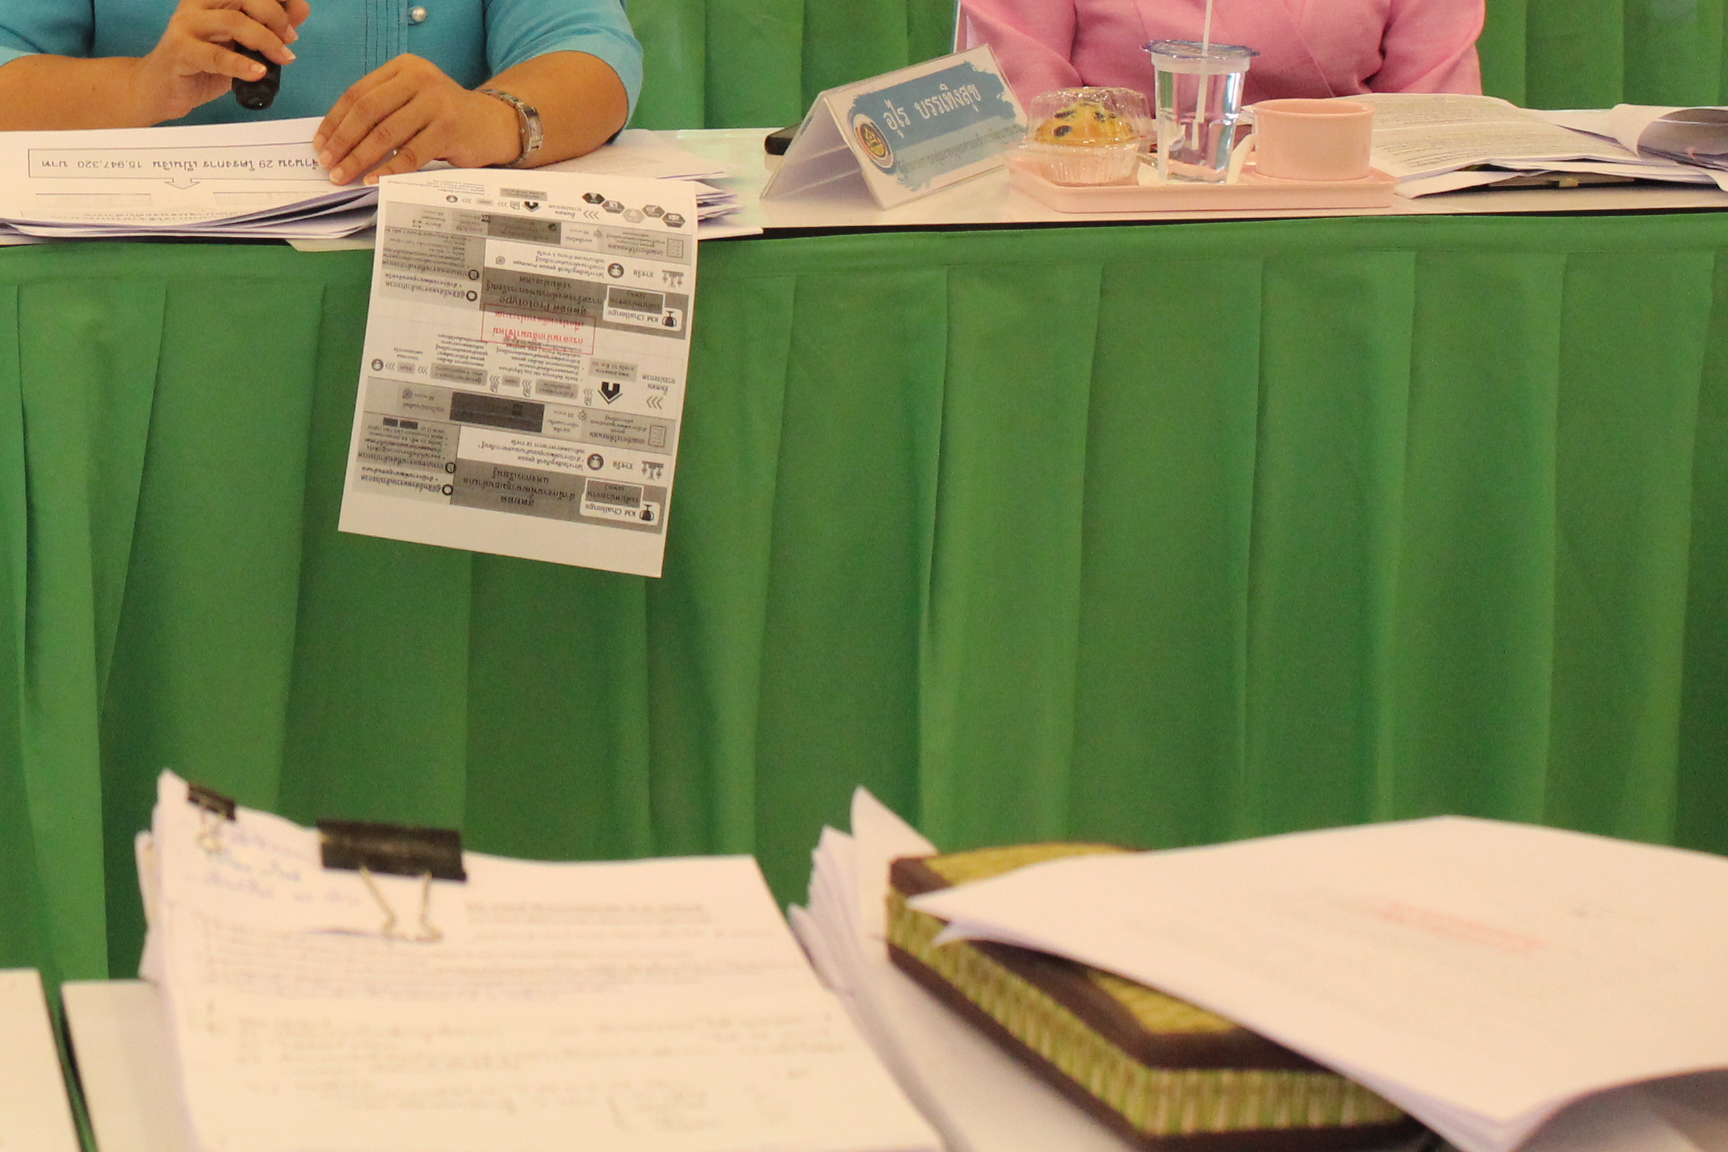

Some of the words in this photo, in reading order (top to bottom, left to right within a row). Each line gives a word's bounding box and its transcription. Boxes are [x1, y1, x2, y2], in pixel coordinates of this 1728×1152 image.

[882, 99, 911, 138] อุไร
[40, 159, 67, 168] บาท
[75, 158, 142, 168] 15,947,320
[151, 159, 197, 171] เป็นเงิน
[201, 159, 255, 171] โครงการ
[257, 158, 273, 169] 29
[277, 157, 318, 170] จำนวน
[498, 294, 549, 311] Prototype
[607, 308, 644, 321] Challenge
[584, 502, 622, 514] Challenge
